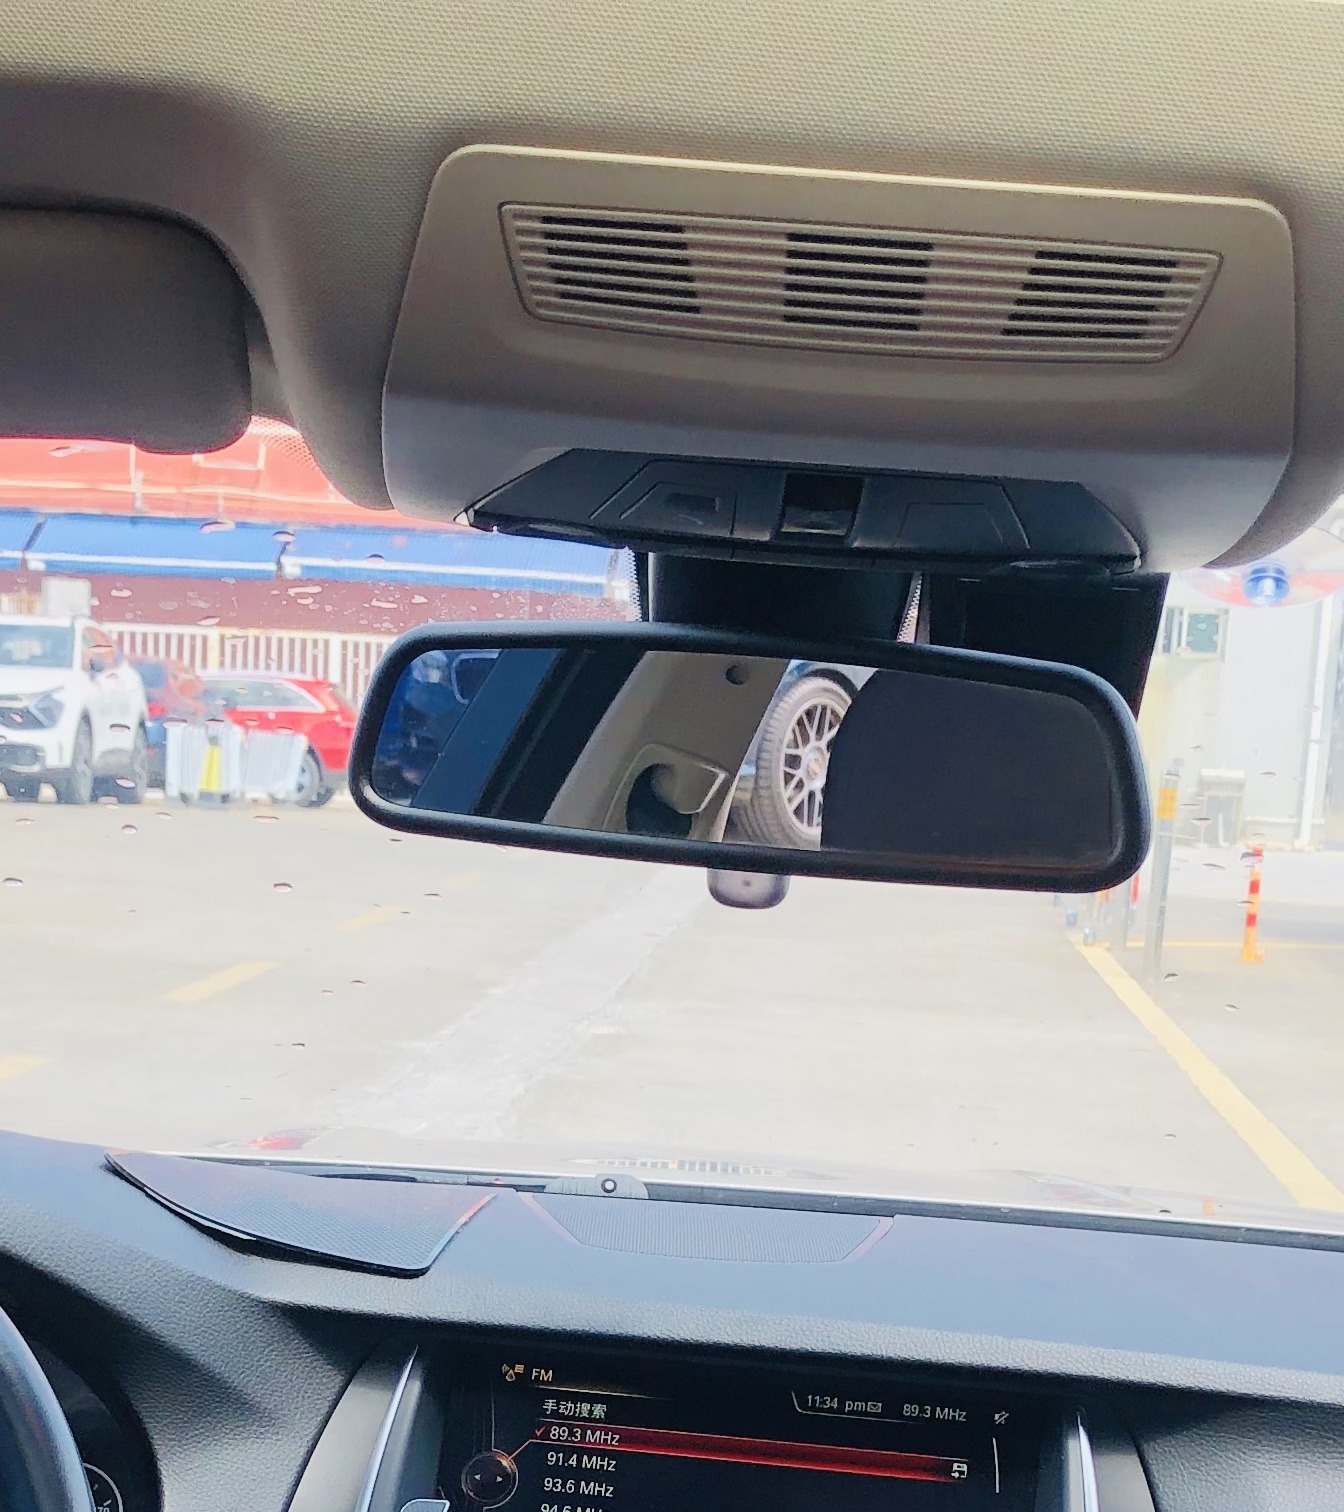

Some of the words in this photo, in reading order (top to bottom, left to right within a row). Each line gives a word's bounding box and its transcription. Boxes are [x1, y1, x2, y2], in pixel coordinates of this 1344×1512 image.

[531, 1367, 554, 1382] FM
[542, 1399, 607, 1419] 手动搜索
[806, 1394, 838, 1410] 11:34
[845, 1401, 866, 1413] pm
[902, 1404, 931, 1419] 89.3
[936, 1407, 967, 1422] MHz
[549, 1425, 581, 1442] 89.3
[586, 1429, 620, 1446] MHz
[547, 1451, 577, 1468] 91.4
[581, 1455, 617, 1471] MHz
[543, 1477, 575, 1493] 93.6
[579, 1480, 614, 1497] MHz
